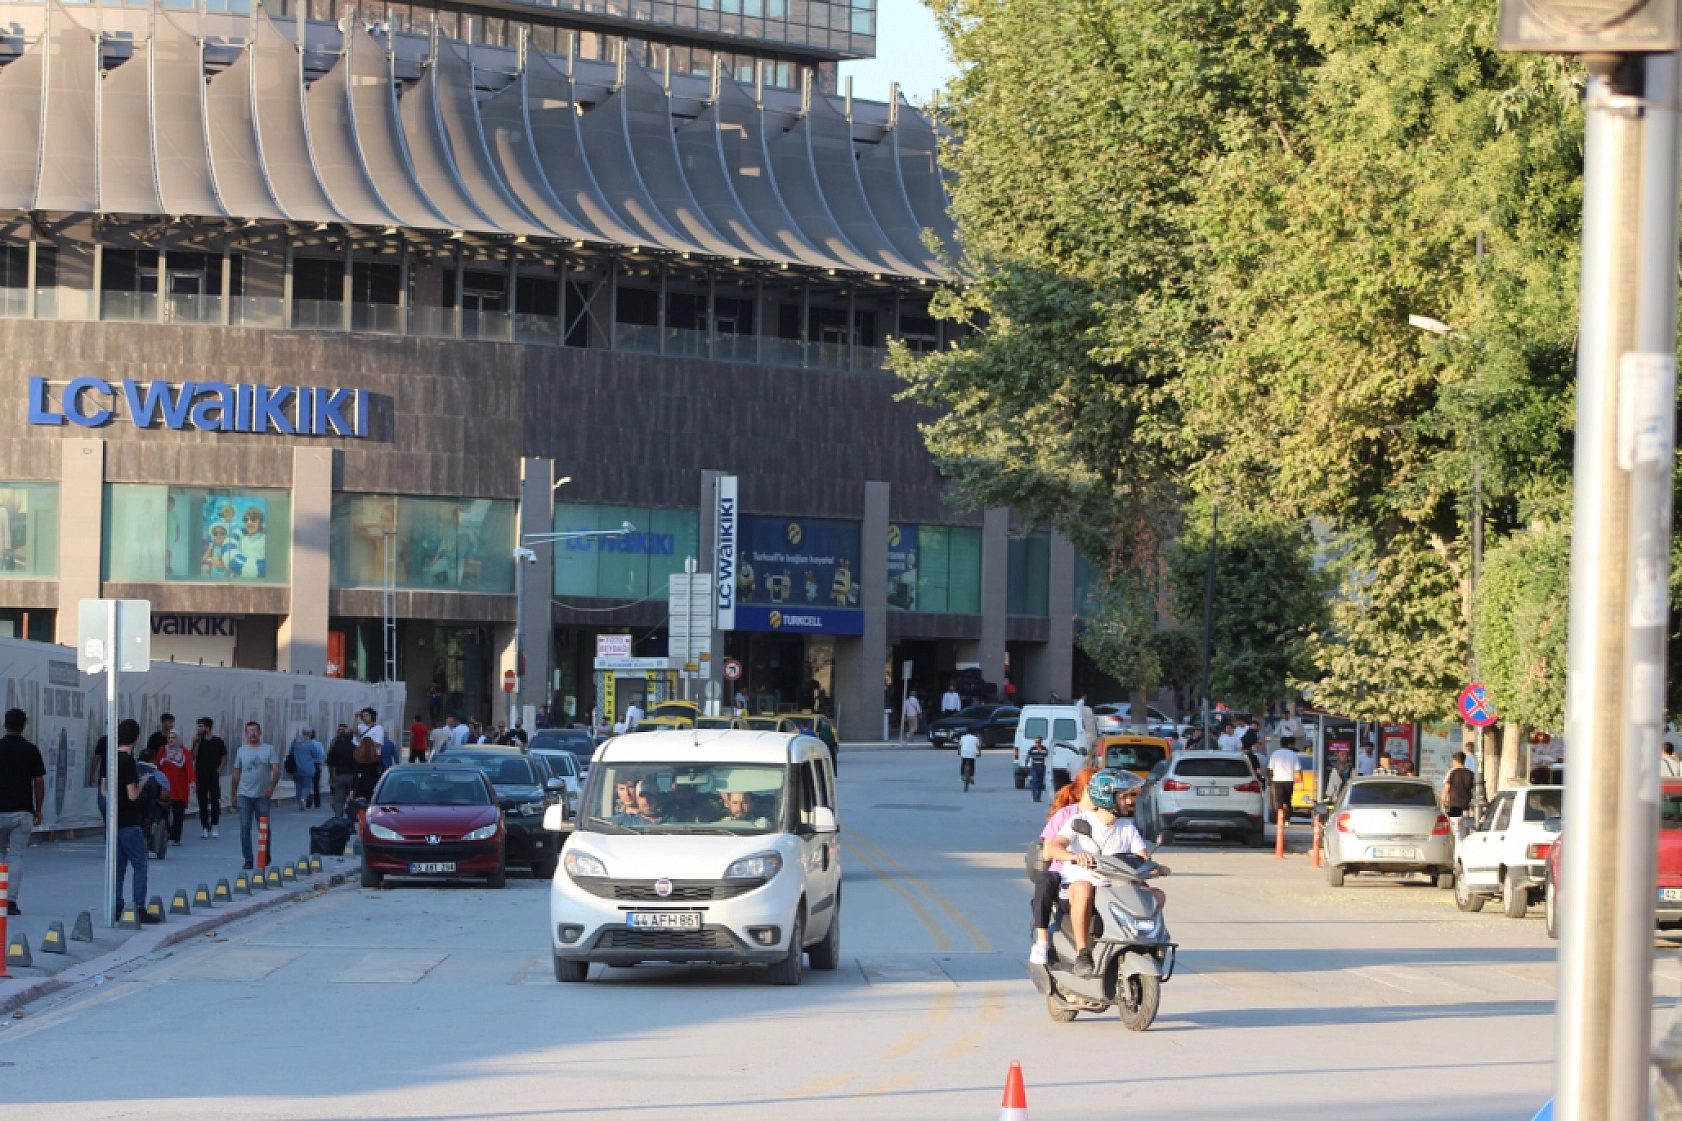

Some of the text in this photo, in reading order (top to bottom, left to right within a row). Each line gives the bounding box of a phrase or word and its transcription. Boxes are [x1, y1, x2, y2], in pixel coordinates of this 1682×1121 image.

[29, 376, 114, 428] LC
[719, 583, 732, 609] LC
[783, 615, 823, 627] TURKCELL
[1665, 889, 1677, 900] 42
[633, 914, 648, 926] 44
[652, 914, 678, 926] AFH
